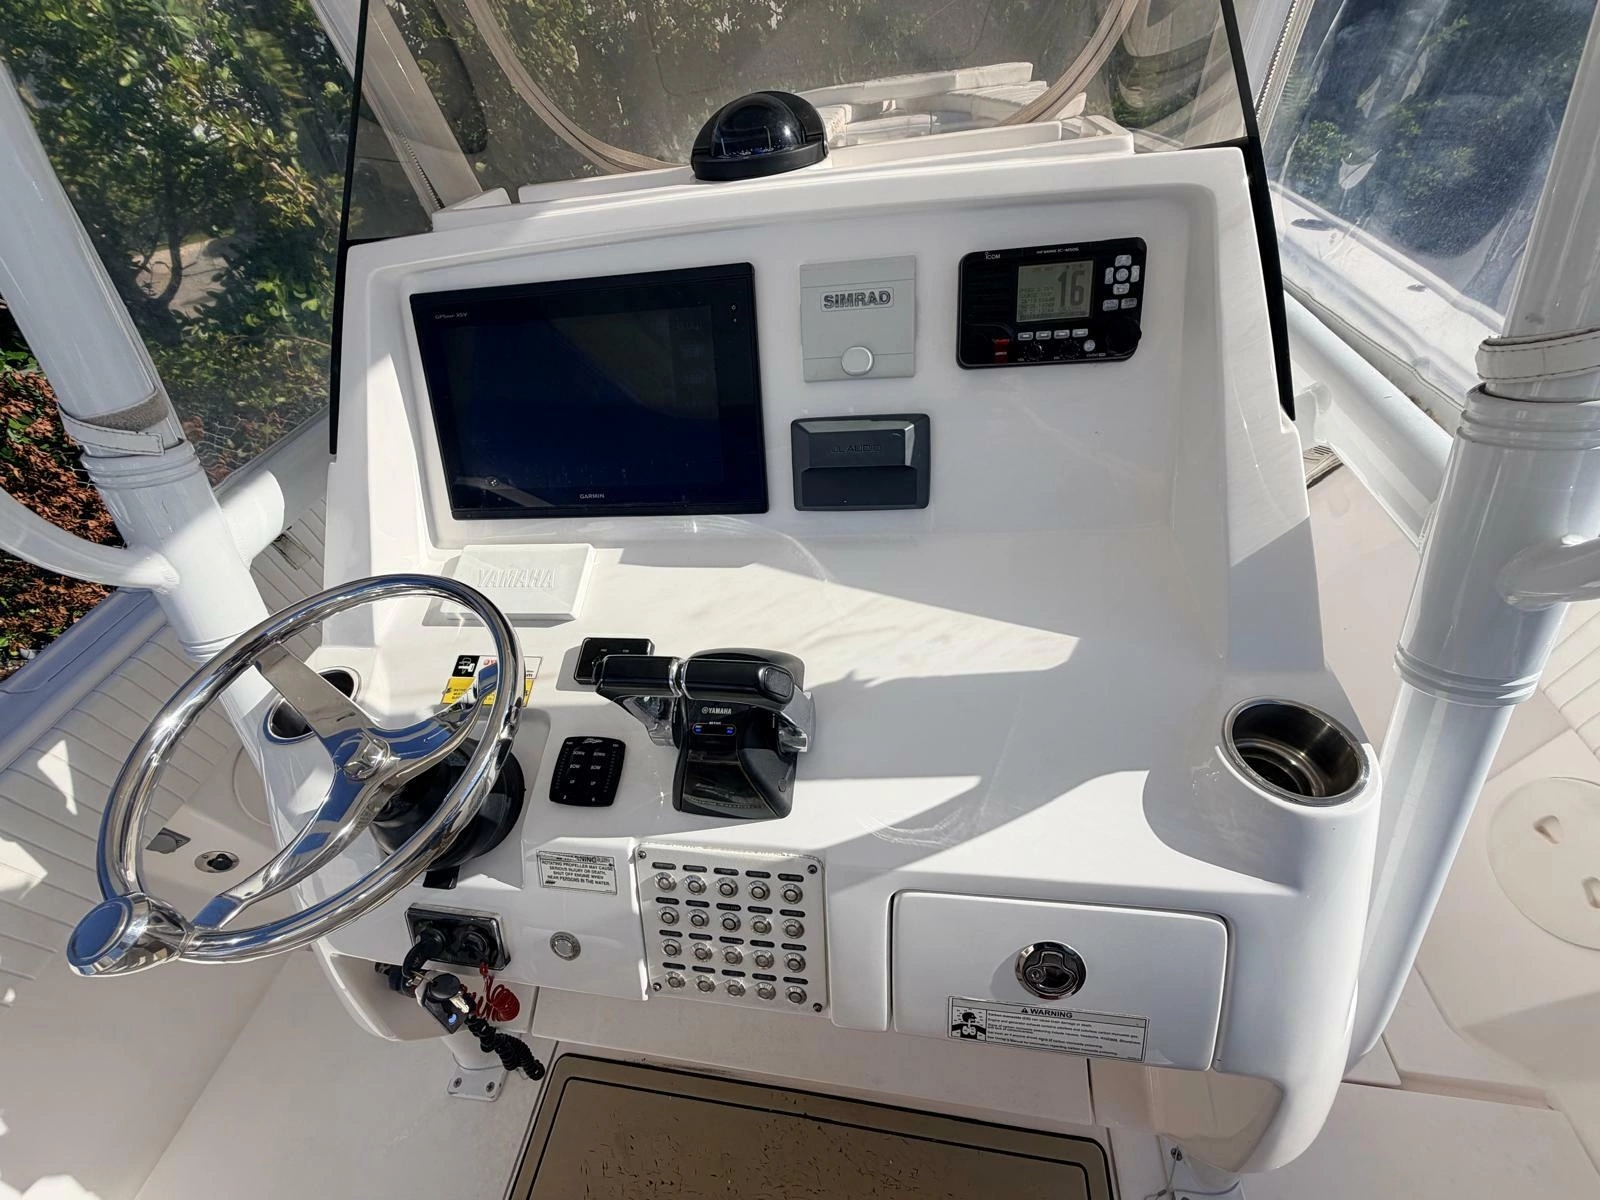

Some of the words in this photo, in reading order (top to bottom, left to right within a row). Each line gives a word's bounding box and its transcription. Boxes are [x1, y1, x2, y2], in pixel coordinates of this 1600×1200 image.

[1057, 270, 1085, 308] 16
[823, 290, 891, 309] SIMRAD
[478, 568, 555, 588] YAMAHA
[708, 707, 732, 715] YAMAHA
[1030, 1008, 1073, 1019] WARNING
